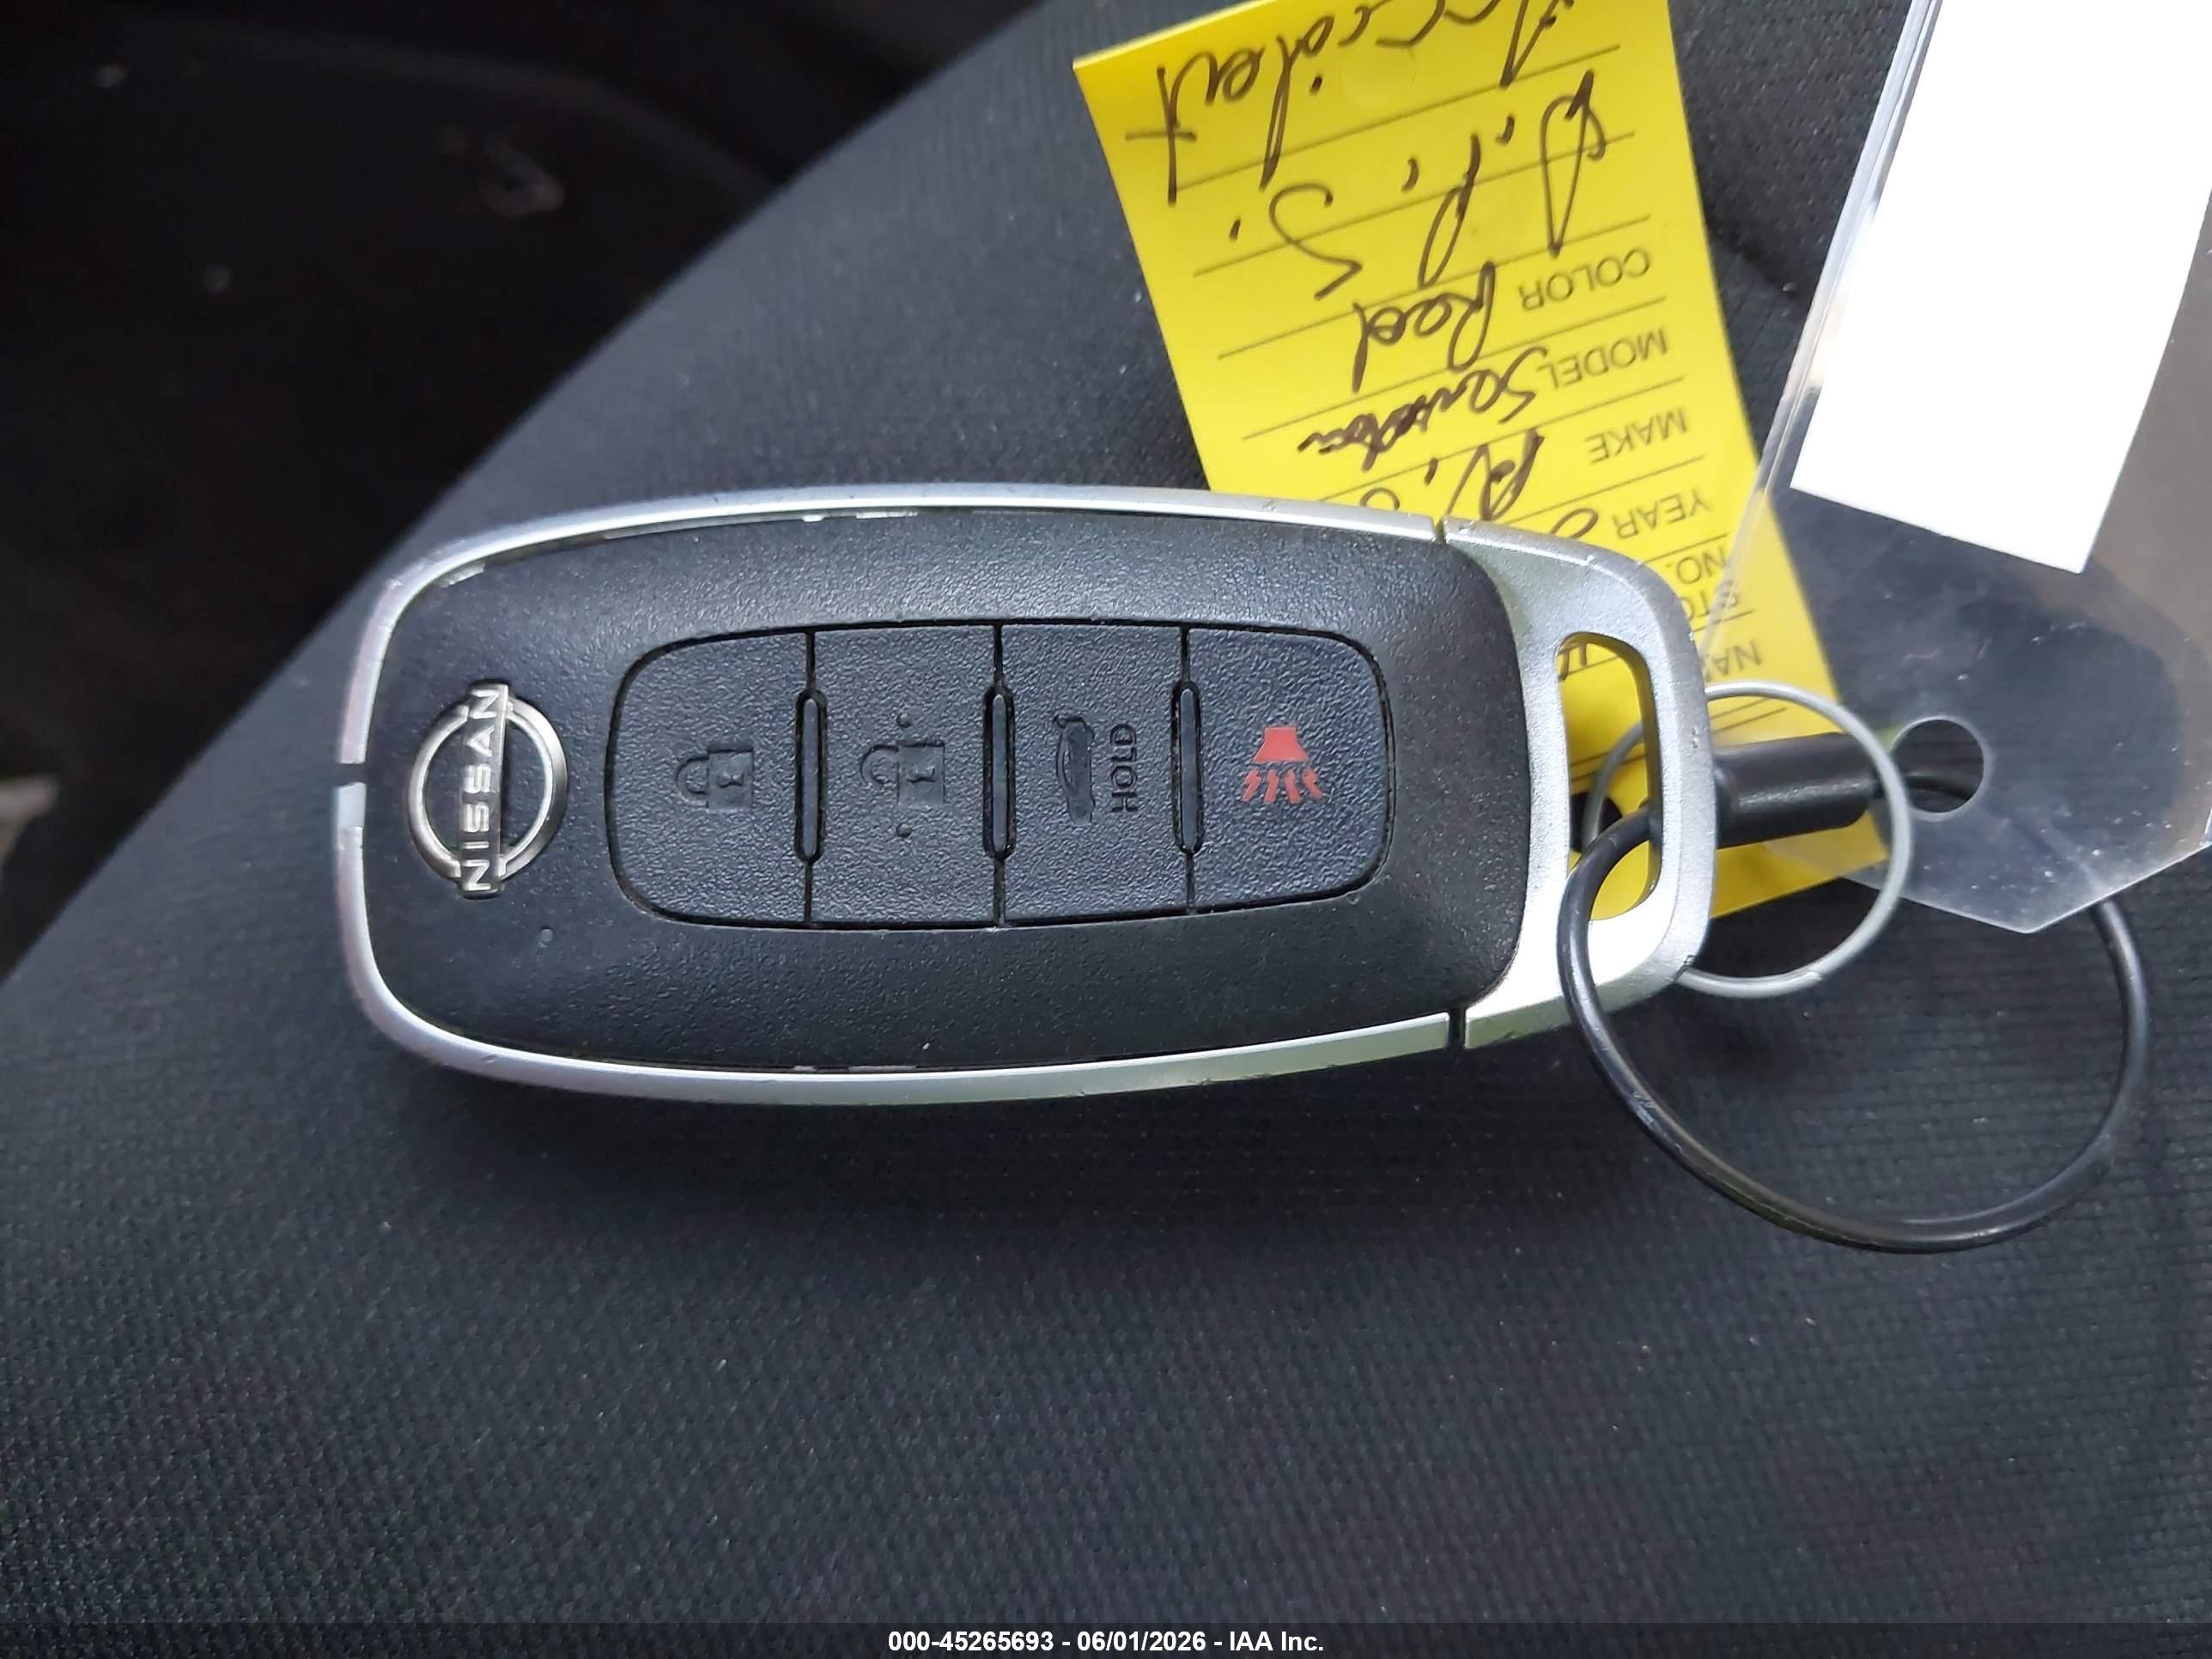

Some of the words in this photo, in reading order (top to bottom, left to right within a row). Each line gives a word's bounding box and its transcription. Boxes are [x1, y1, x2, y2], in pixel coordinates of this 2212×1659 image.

[1518, 247, 1650, 312] COLOR
[1351, 261, 1497, 393] Red
[1536, 325, 1668, 390] MODEL
[1584, 405, 1688, 464] MAKE
[1611, 487, 1712, 540] YEAR
[462, 685, 508, 893] NISSAN
[1109, 723, 1139, 812] HOLD
